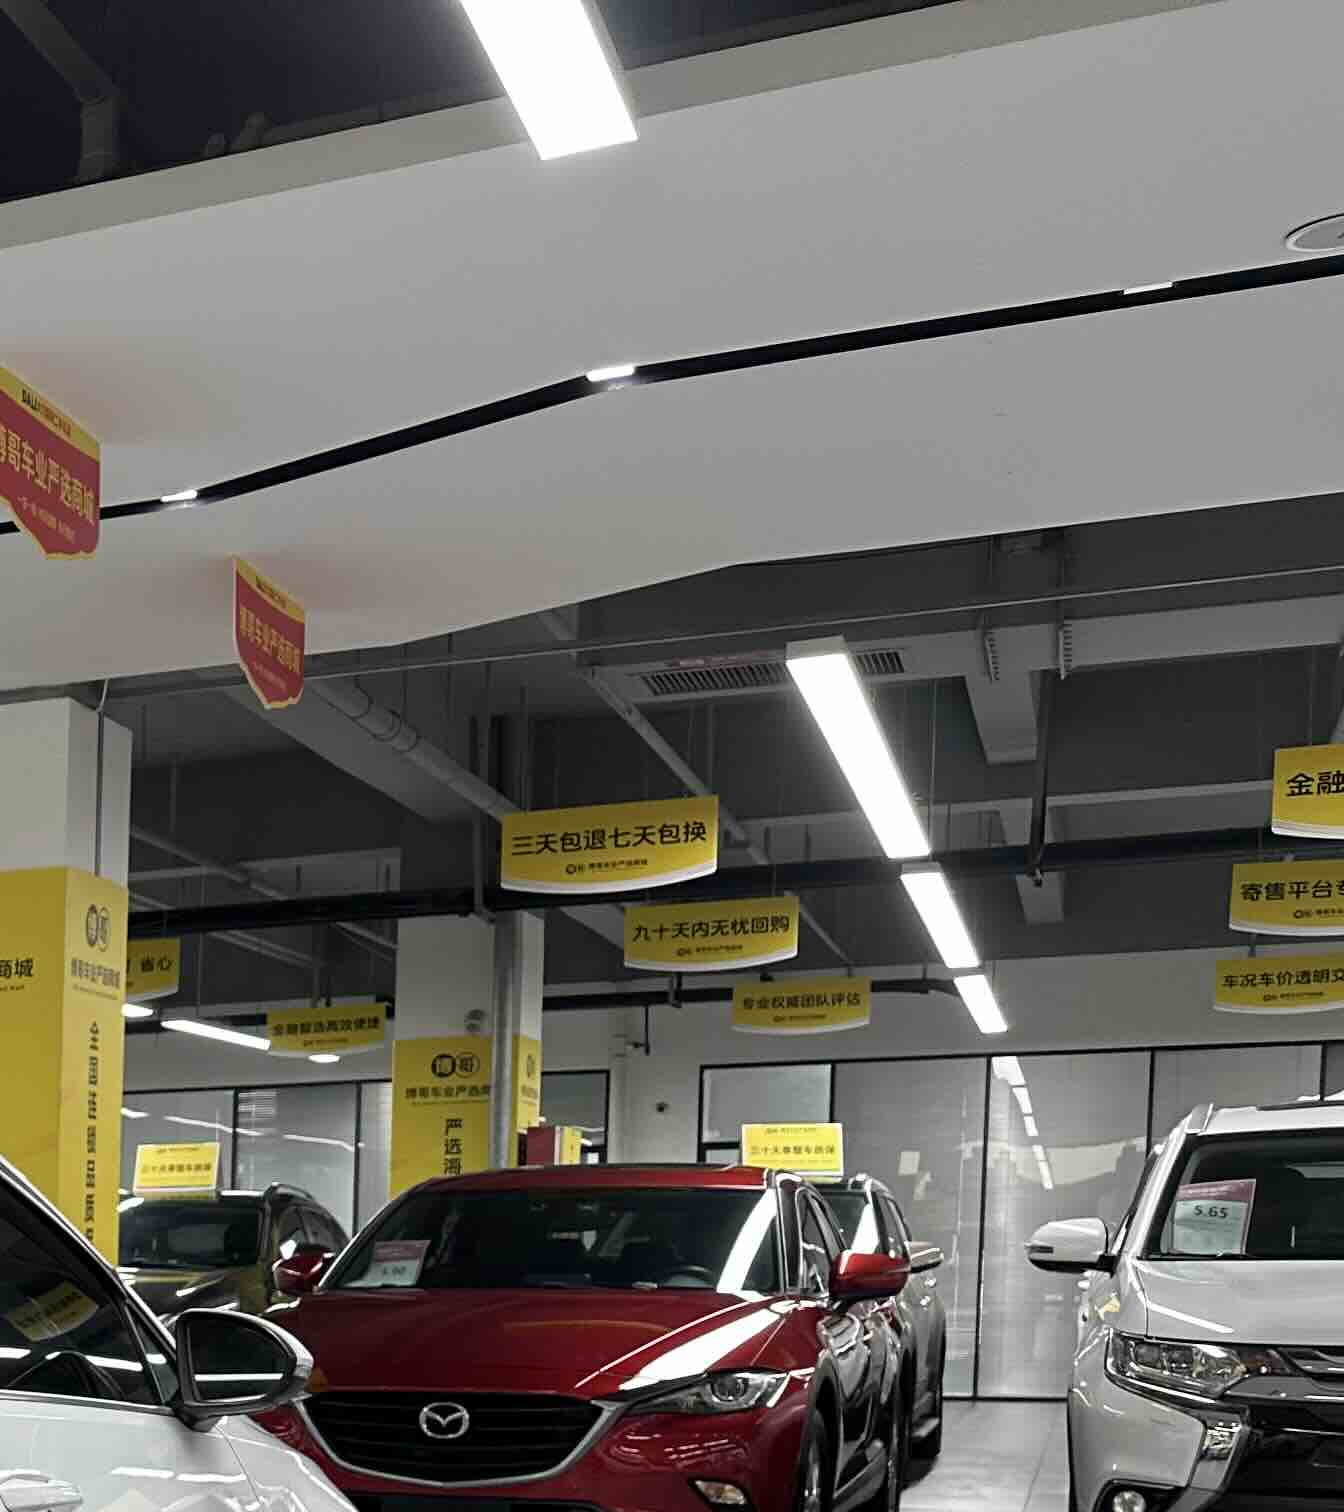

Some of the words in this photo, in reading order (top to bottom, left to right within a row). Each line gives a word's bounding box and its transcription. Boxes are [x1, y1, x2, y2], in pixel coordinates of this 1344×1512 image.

[1286, 771, 1344, 797] 金融
[511, 821, 707, 856] 三天包退七天包换
[632, 916, 790, 942] 九十天内无忧回购
